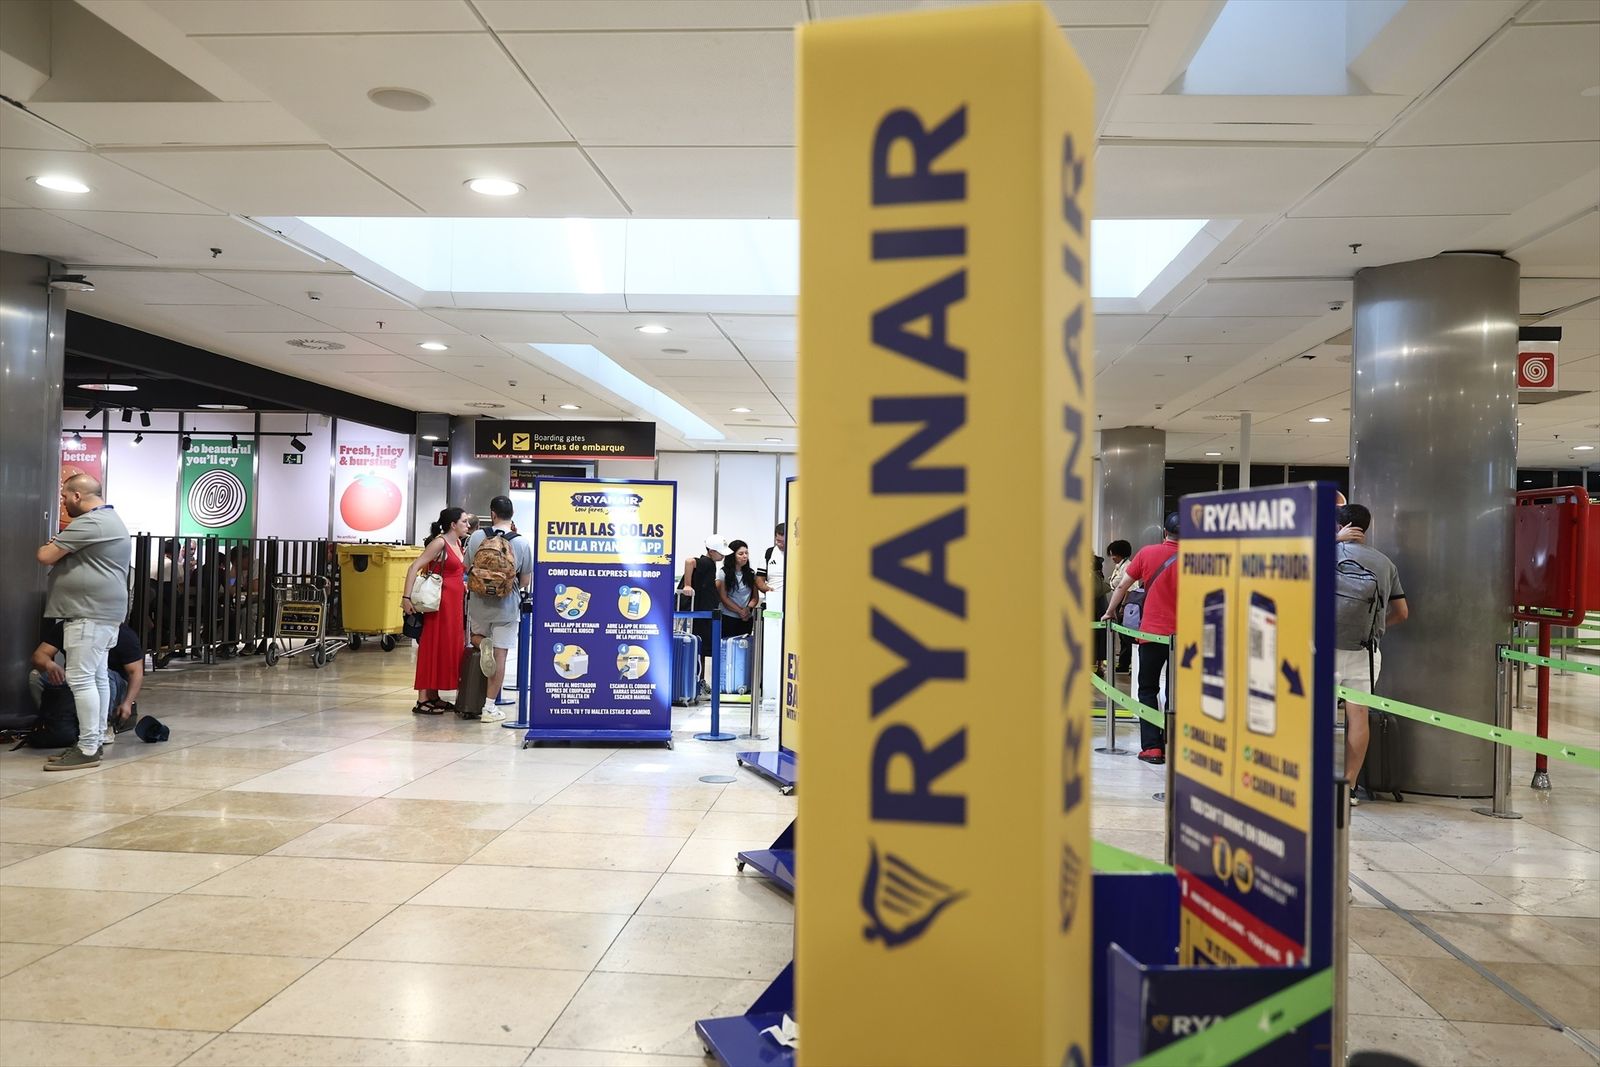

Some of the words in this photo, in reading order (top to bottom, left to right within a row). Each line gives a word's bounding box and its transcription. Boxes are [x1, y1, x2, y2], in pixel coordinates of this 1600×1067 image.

[534, 434, 564, 442] Boarding
[64, 452, 96, 461] better
[340, 445, 374, 456] Fresh,
[376, 445, 404, 458] juicy
[569, 443, 580, 451] de
[582, 443, 625, 454] embarque
[186, 455, 218, 466] you'll
[219, 456, 238, 467] cry
[340, 456, 348, 465] &
[349, 456, 396, 469] bursting
[870, 102, 967, 827] RYANAIR
[1062, 131, 1084, 815] RYANAIR
[583, 495, 638, 505] RYANAIR
[1204, 498, 1296, 532] RYANAIR
[547, 522, 586, 535] EVITA
[590, 522, 615, 536] LAS
[620, 524, 664, 537] COLAS
[549, 540, 572, 551] CON
[575, 540, 588, 551] LA
[642, 542, 662, 554] APP
[1183, 553, 1230, 577] PRIORITY
[1242, 554, 1310, 580] NON-PRIOR
[1190, 726, 1211, 747] SMALL
[1213, 734, 1226, 752] BAG
[1210, 758, 1222, 776] BAG
[1254, 748, 1280, 773] SMALL
[1282, 758, 1298, 780] BAG
[1280, 786, 1296, 808] BAG
